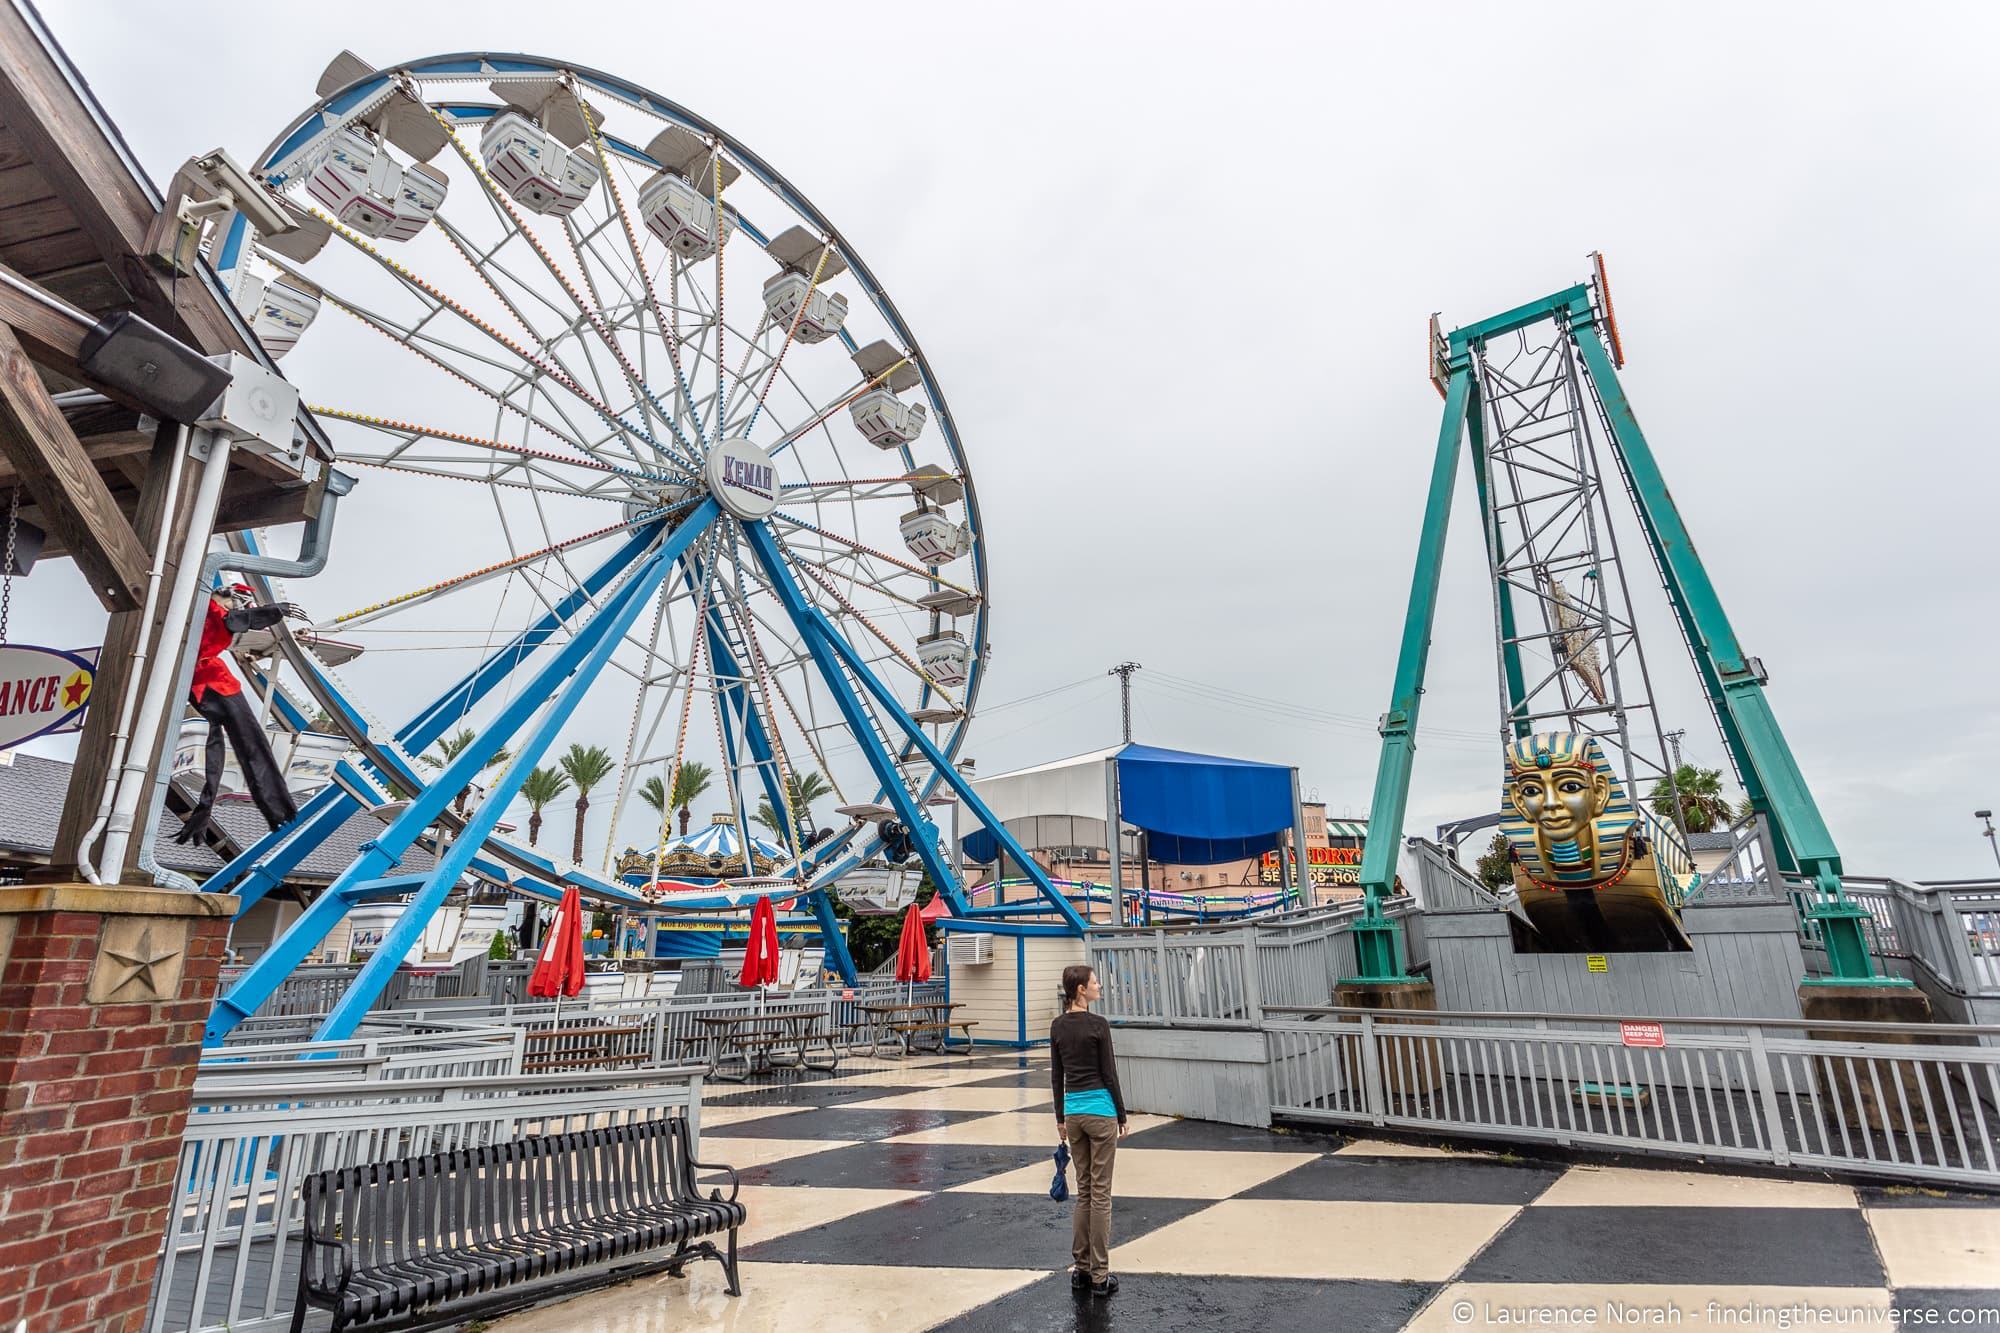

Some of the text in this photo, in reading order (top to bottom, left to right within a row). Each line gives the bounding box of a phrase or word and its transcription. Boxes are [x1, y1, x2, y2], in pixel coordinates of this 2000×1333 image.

[531, 118, 539, 127] 5
[682, 174, 690, 185] 6
[723, 455, 772, 491] KEMAH
[1263, 847, 1362, 868] LDRY'
[1263, 871, 1360, 884] SEFOD HOU
[600, 961, 618, 972] 14
